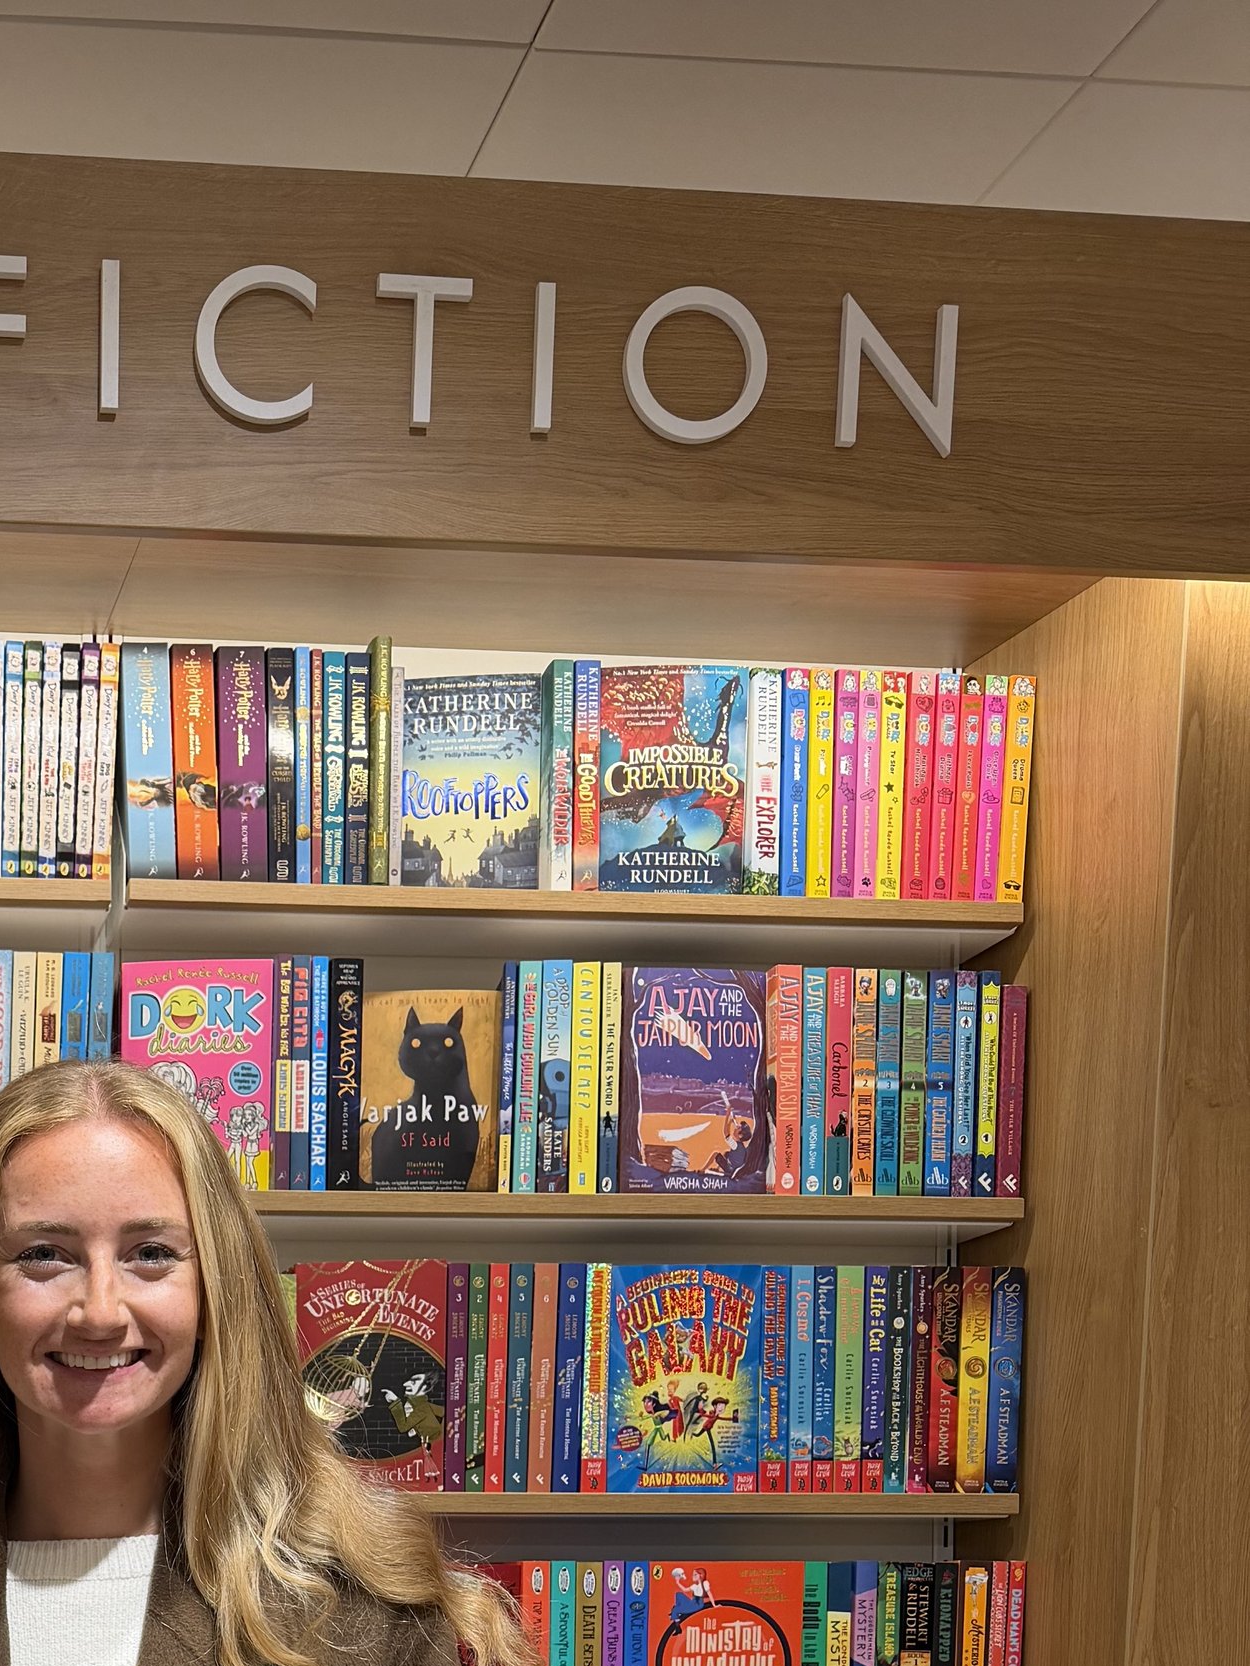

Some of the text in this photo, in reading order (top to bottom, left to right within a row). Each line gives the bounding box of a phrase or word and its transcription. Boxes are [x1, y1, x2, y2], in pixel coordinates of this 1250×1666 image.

[404, 693, 533, 714] KATHERINE
[414, 714, 520, 734] RUNDELL
[629, 745, 724, 764] IMPOSSIBLE
[605, 761, 739, 797] CREATURES
[402, 769, 530, 820] ROOFTOPPERS
[755, 774, 778, 860] THE EXPLORER
[618, 852, 720, 867] KATHERINE
[630, 869, 713, 884] RUNDELL
[135, 970, 175, 988] Rachel
[216, 967, 260, 985] Russell
[129, 985, 265, 1040] DORK
[649, 987, 743, 1017] AJAY AND
[719, 1002, 743, 1016] THE
[148, 1032, 252, 1057] diaries
[638, 1017, 757, 1048] JAIPUR MOON
[335, 1024, 359, 1097] MAGYK
[312, 1052, 326, 1166] LOUIS SACHAR
[444, 1095, 489, 1123] Paw
[401, 1132, 450, 1147] SF Said
[664, 1177, 728, 1190] VARSHA SHAH
[315, 1279, 356, 1299] SERIES
[303, 1288, 439, 1323] UNFORTUNATE
[616, 1285, 754, 1343] RULING THE
[378, 1302, 436, 1341] EVENTS
[625, 1320, 748, 1388] GALAXY
[642, 1472, 724, 1487] DAVID SOLOMONS
[686, 1620, 774, 1654] MINISTRY of
